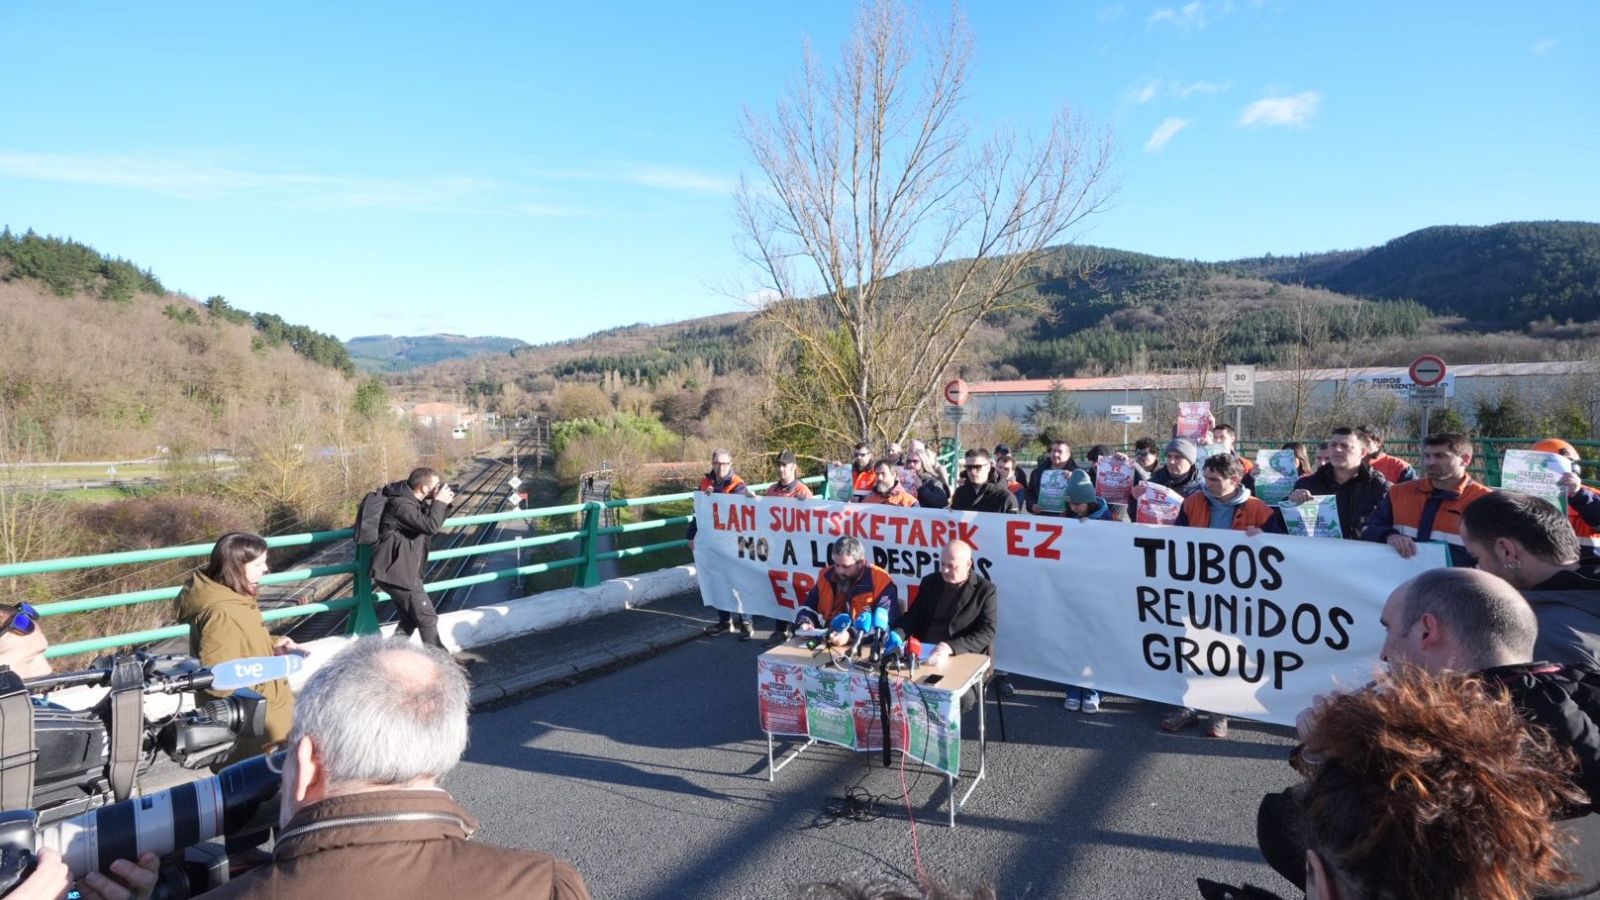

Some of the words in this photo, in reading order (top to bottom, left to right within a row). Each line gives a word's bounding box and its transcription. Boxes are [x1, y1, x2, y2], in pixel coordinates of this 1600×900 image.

[713, 502, 756, 533] LAN
[1006, 520, 1064, 561] EZ
[738, 536, 769, 562] NO
[782, 539, 798, 566] A
[1134, 537, 1286, 591] TUBOS
[234, 662, 264, 678] tve
[1142, 633, 1304, 690] GROUP
